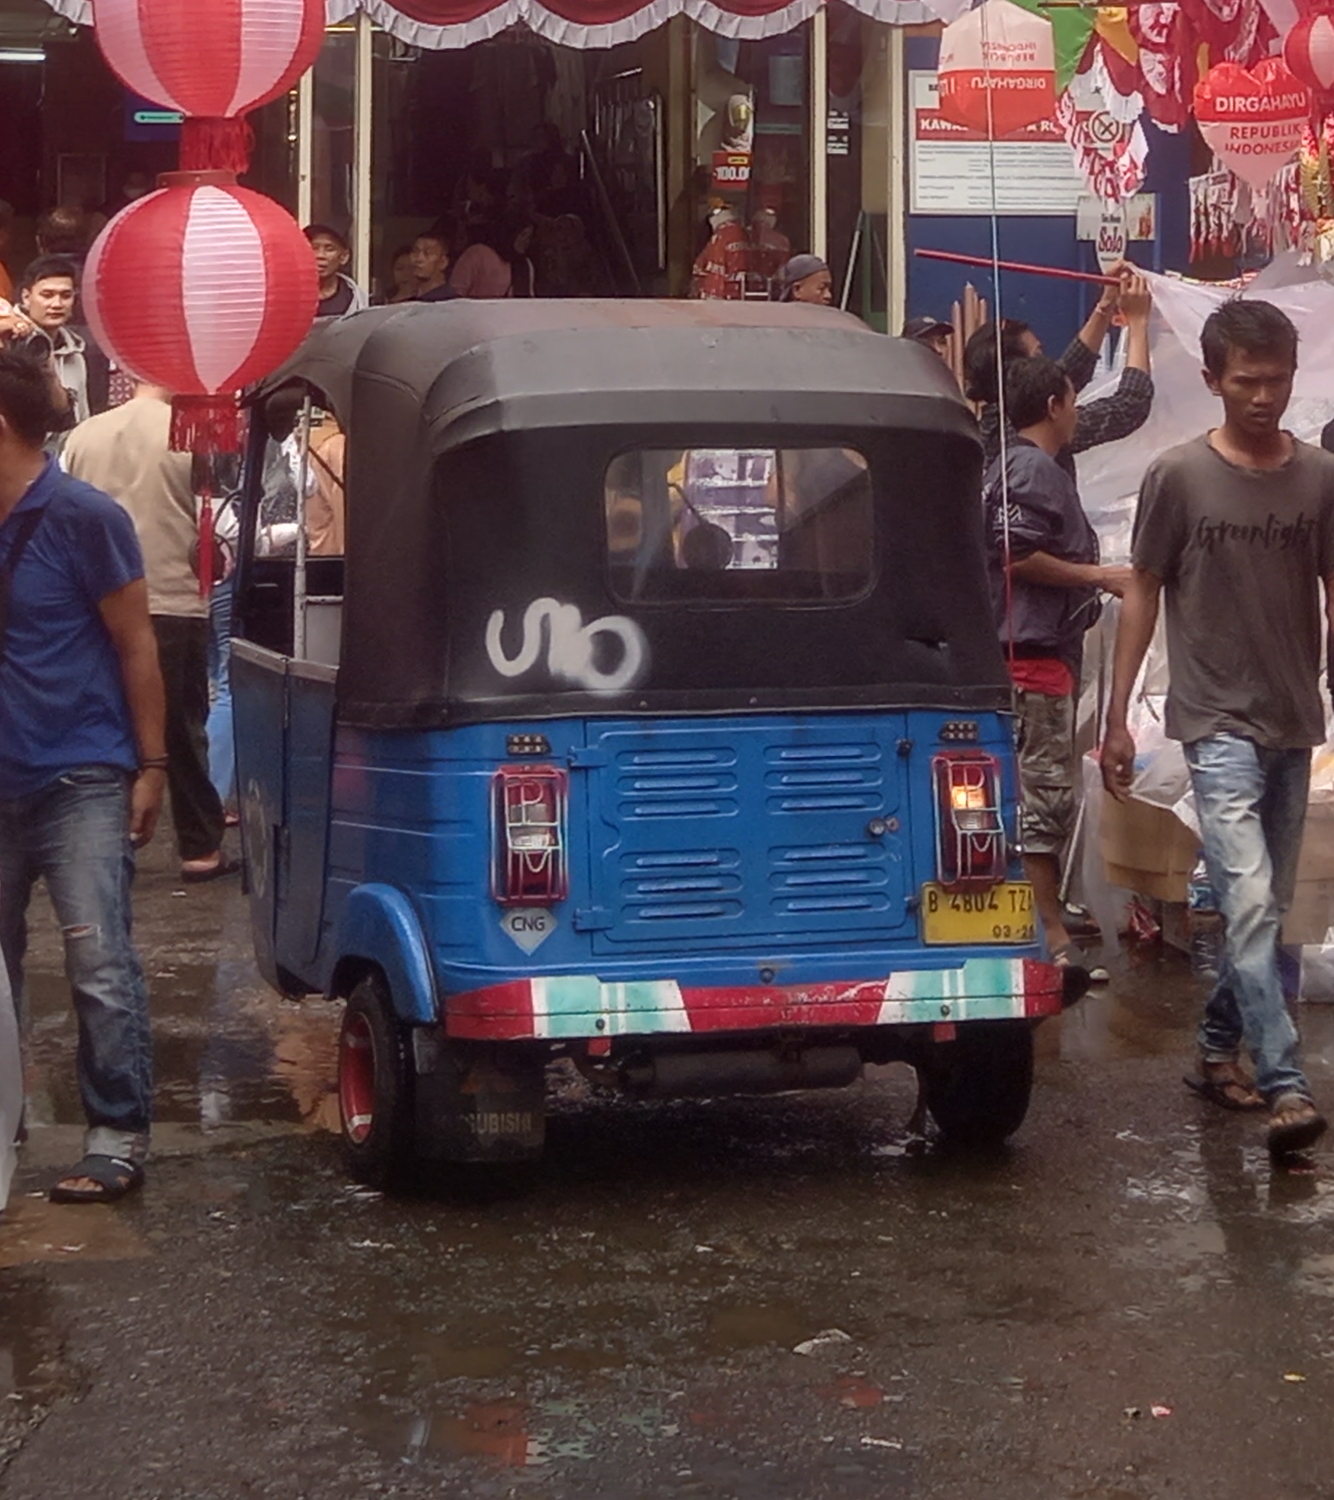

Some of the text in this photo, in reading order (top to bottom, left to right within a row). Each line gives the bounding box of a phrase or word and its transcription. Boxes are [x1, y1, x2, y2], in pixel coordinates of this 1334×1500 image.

[970, 76, 1047, 90] DIRGAHAYU
[1215, 92, 1306, 113] DIRGAHAYU
[1230, 122, 1302, 140] REPUBLIK
[1197, 511, 1317, 554] Greenlight
[928, 890, 938, 913] B
[951, 891, 999, 913] 4804
[511, 916, 545, 932] CNG
